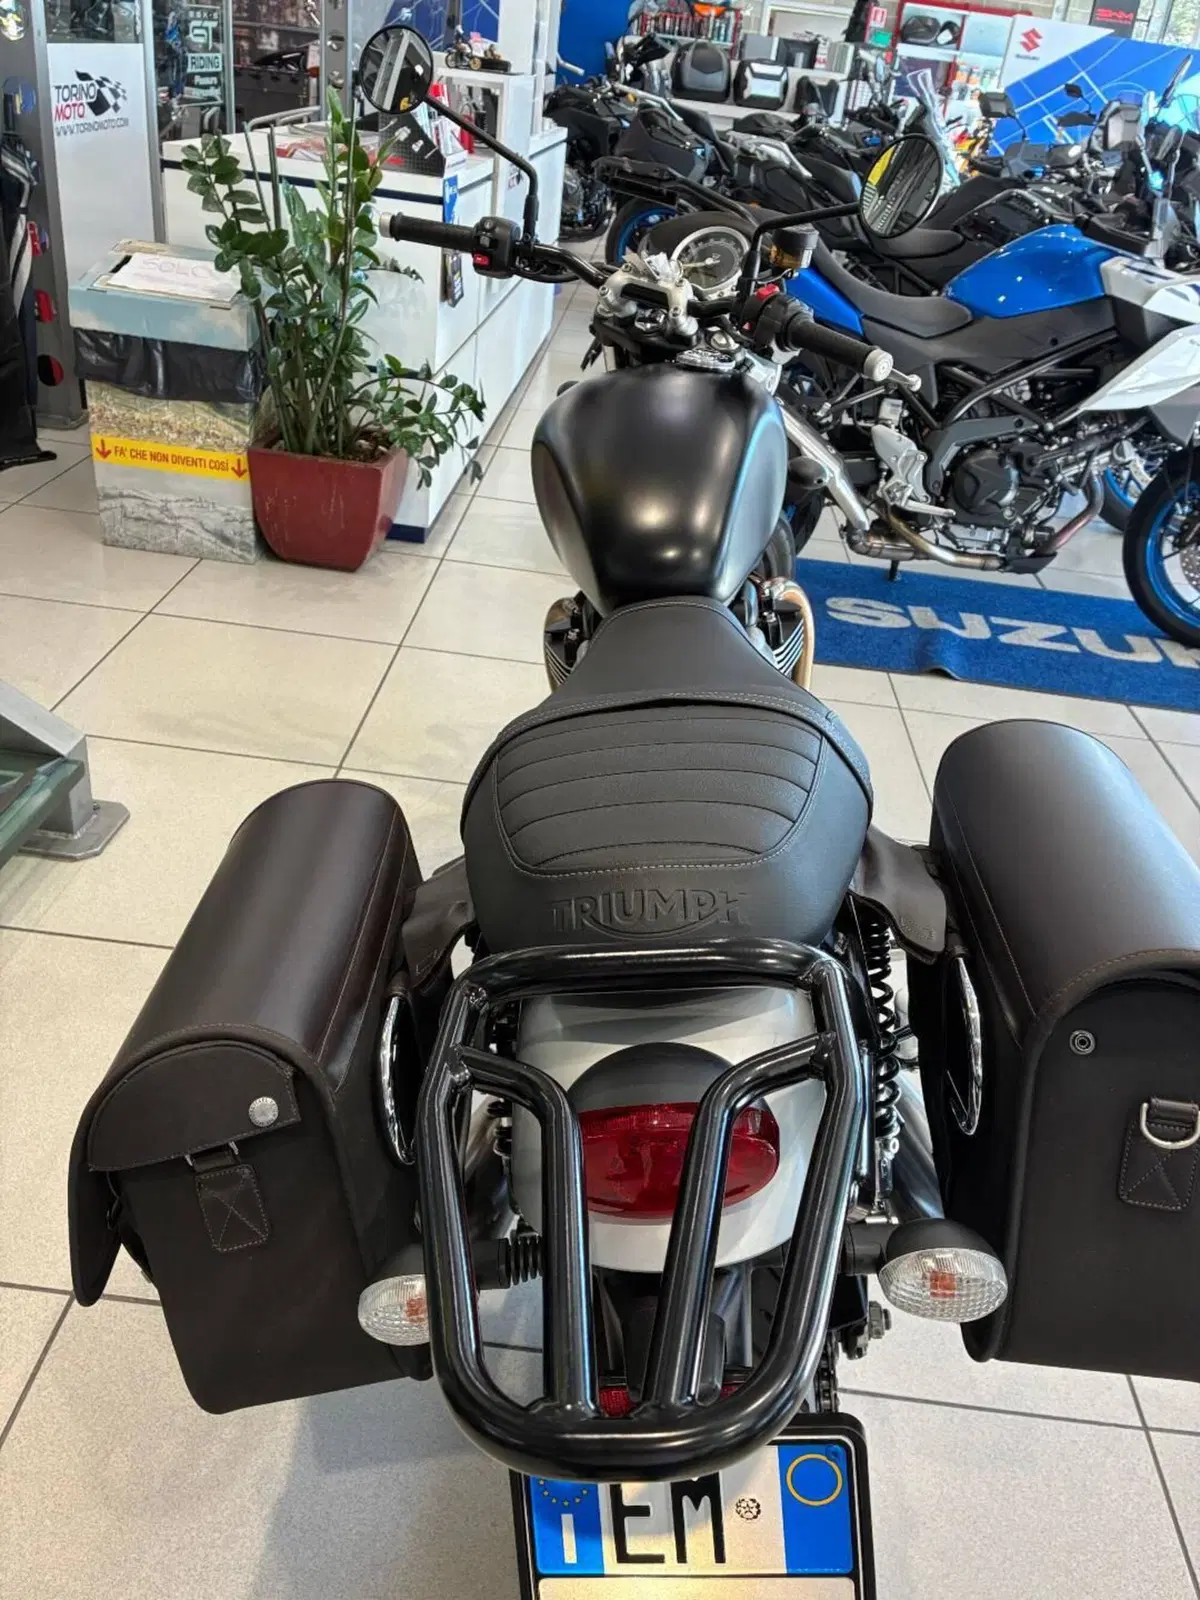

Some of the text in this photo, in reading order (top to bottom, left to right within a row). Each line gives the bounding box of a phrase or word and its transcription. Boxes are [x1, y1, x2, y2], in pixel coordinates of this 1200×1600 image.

[190, 56, 220, 70] RIDING
[54, 83, 96, 102] TORINO
[55, 102, 85, 121] MOTO
[114, 446, 127, 458] FA'
[130, 447, 148, 461] CHE
[150, 451, 169, 464] NON
[171, 453, 207, 469] DIVENTI
[551, 889, 748, 938] TRIUMPH
